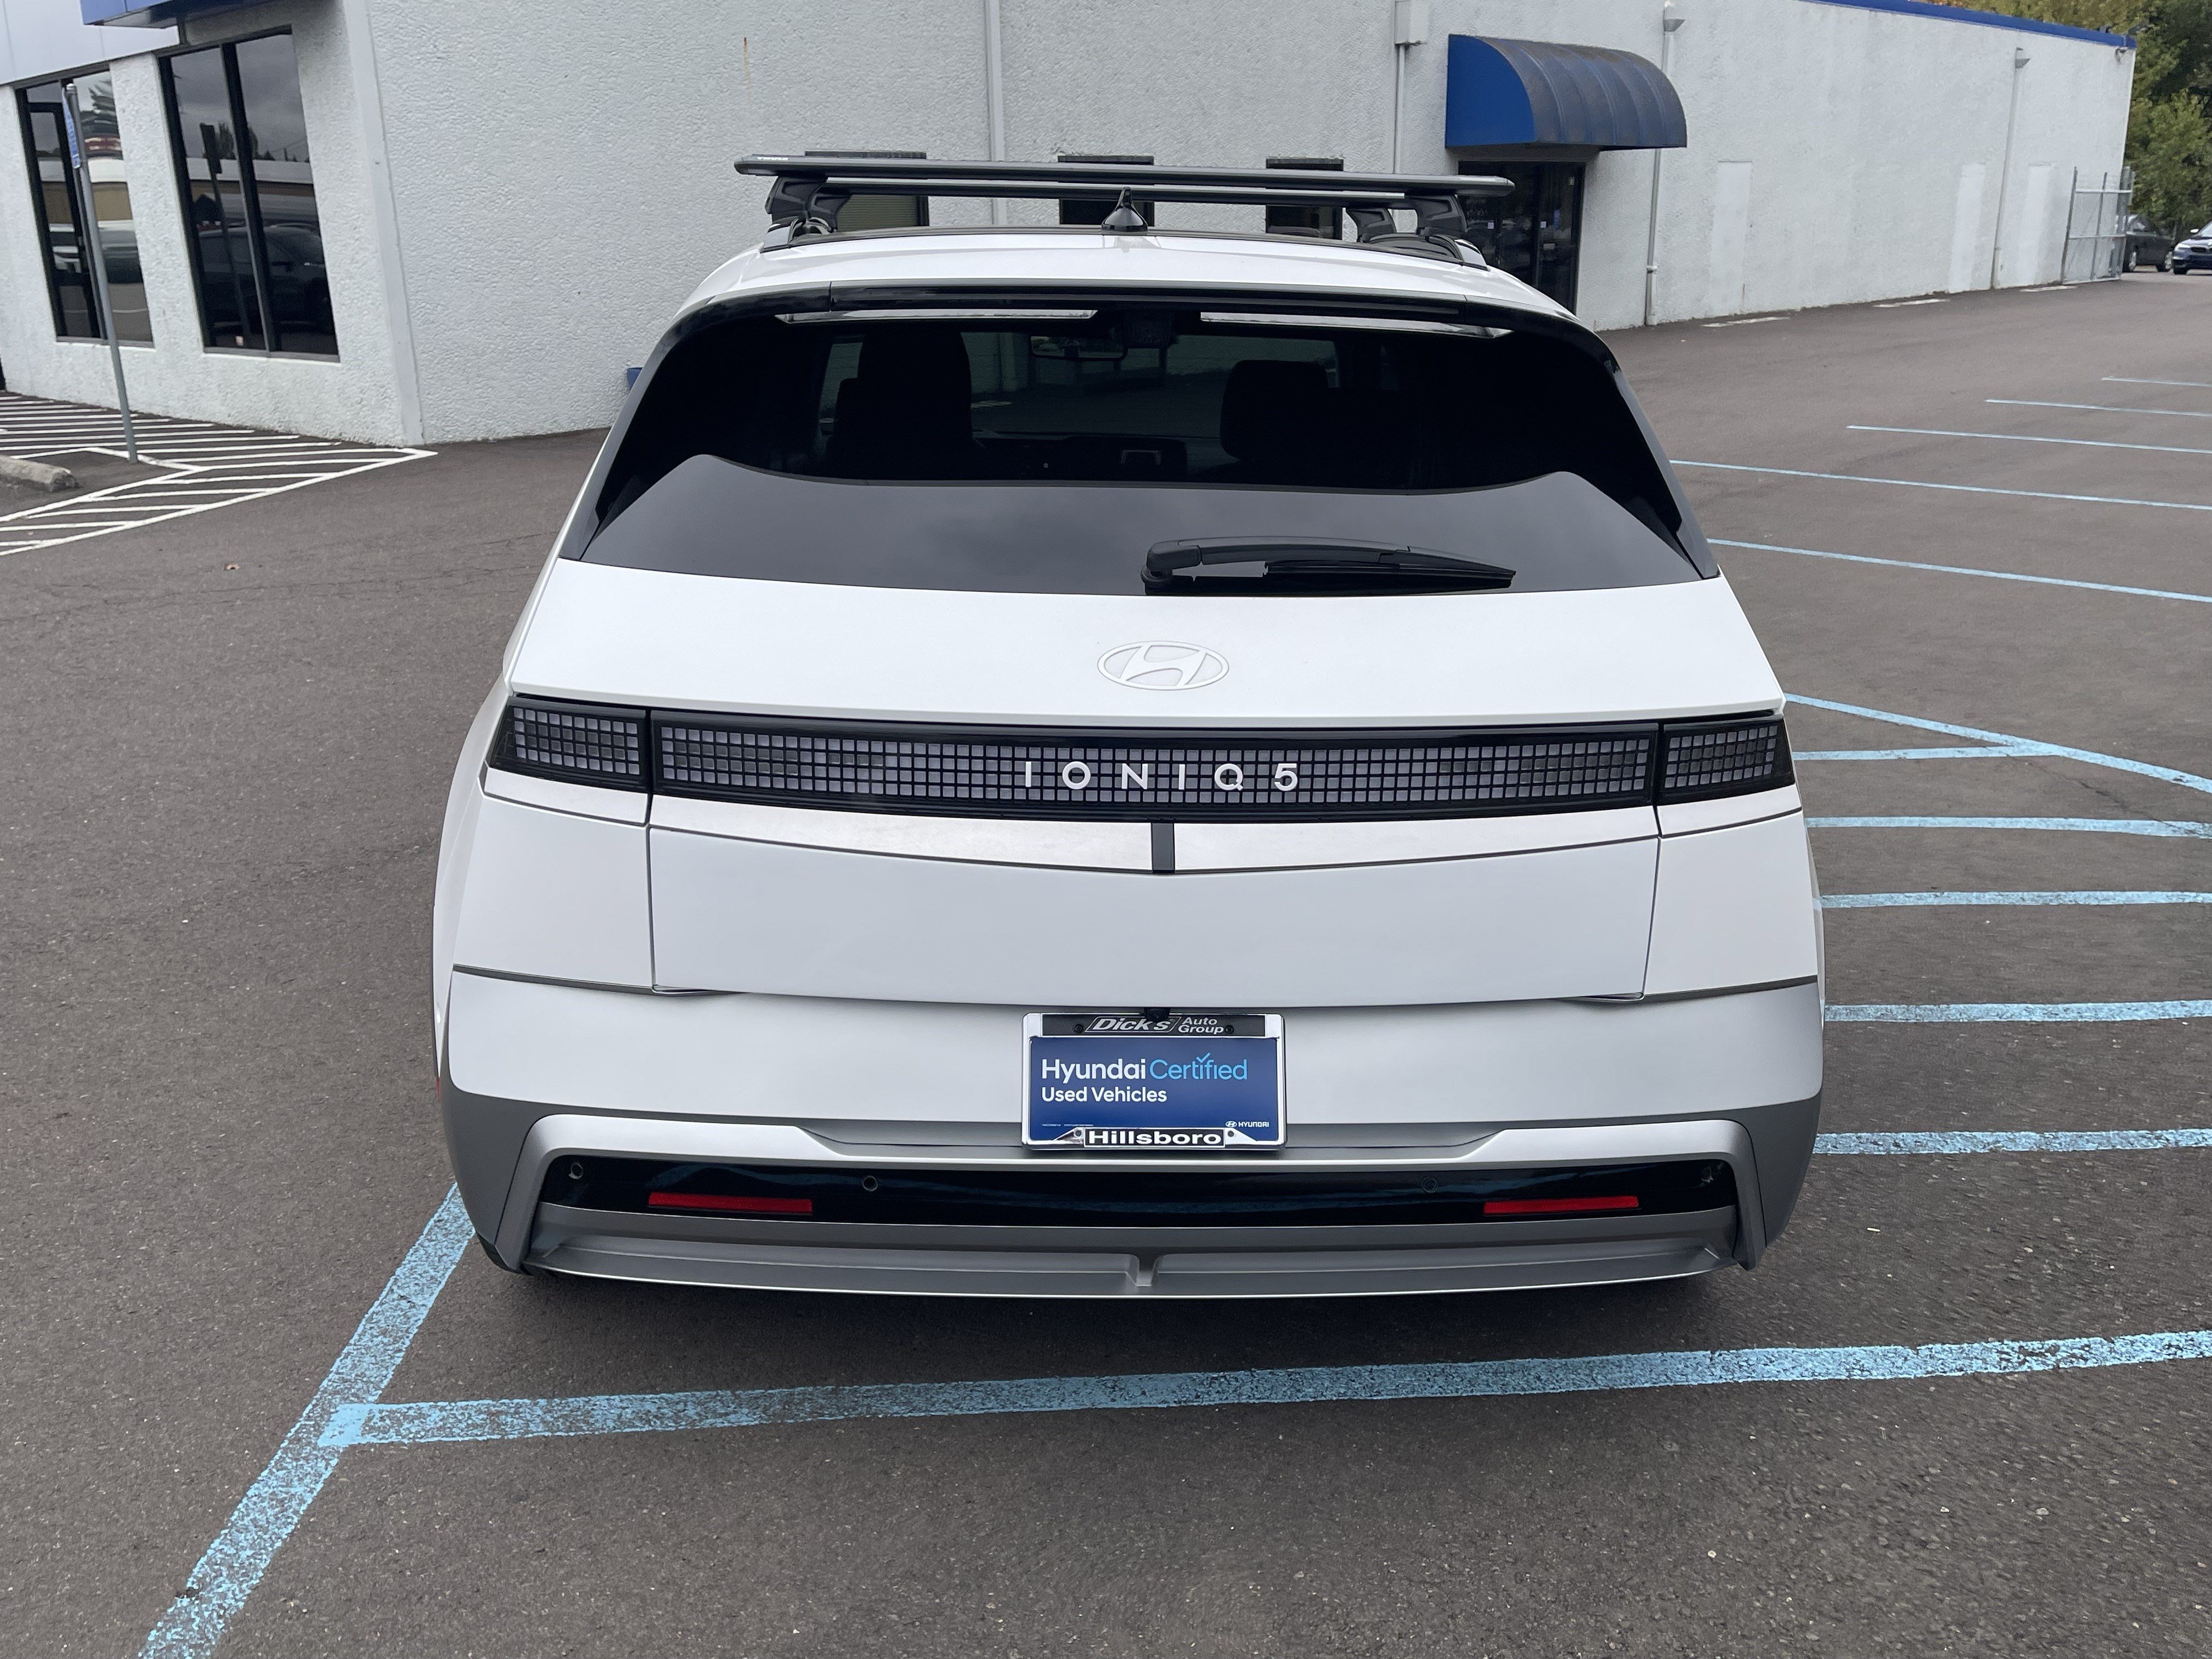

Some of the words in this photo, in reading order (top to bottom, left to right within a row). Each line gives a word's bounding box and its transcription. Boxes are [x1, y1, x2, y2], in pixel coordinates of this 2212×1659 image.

[1092, 1018, 1171, 1031] Dicks
[1182, 1017, 1217, 1025] Auto
[1178, 1025, 1224, 1034] Group
[1042, 1058, 1146, 1084] Hyundai
[1149, 1053, 1248, 1080] Certified
[1042, 1086, 1087, 1102] Used
[1091, 1086, 1167, 1102] Vehicles
[1088, 1130, 1222, 1145] Hillsboro
